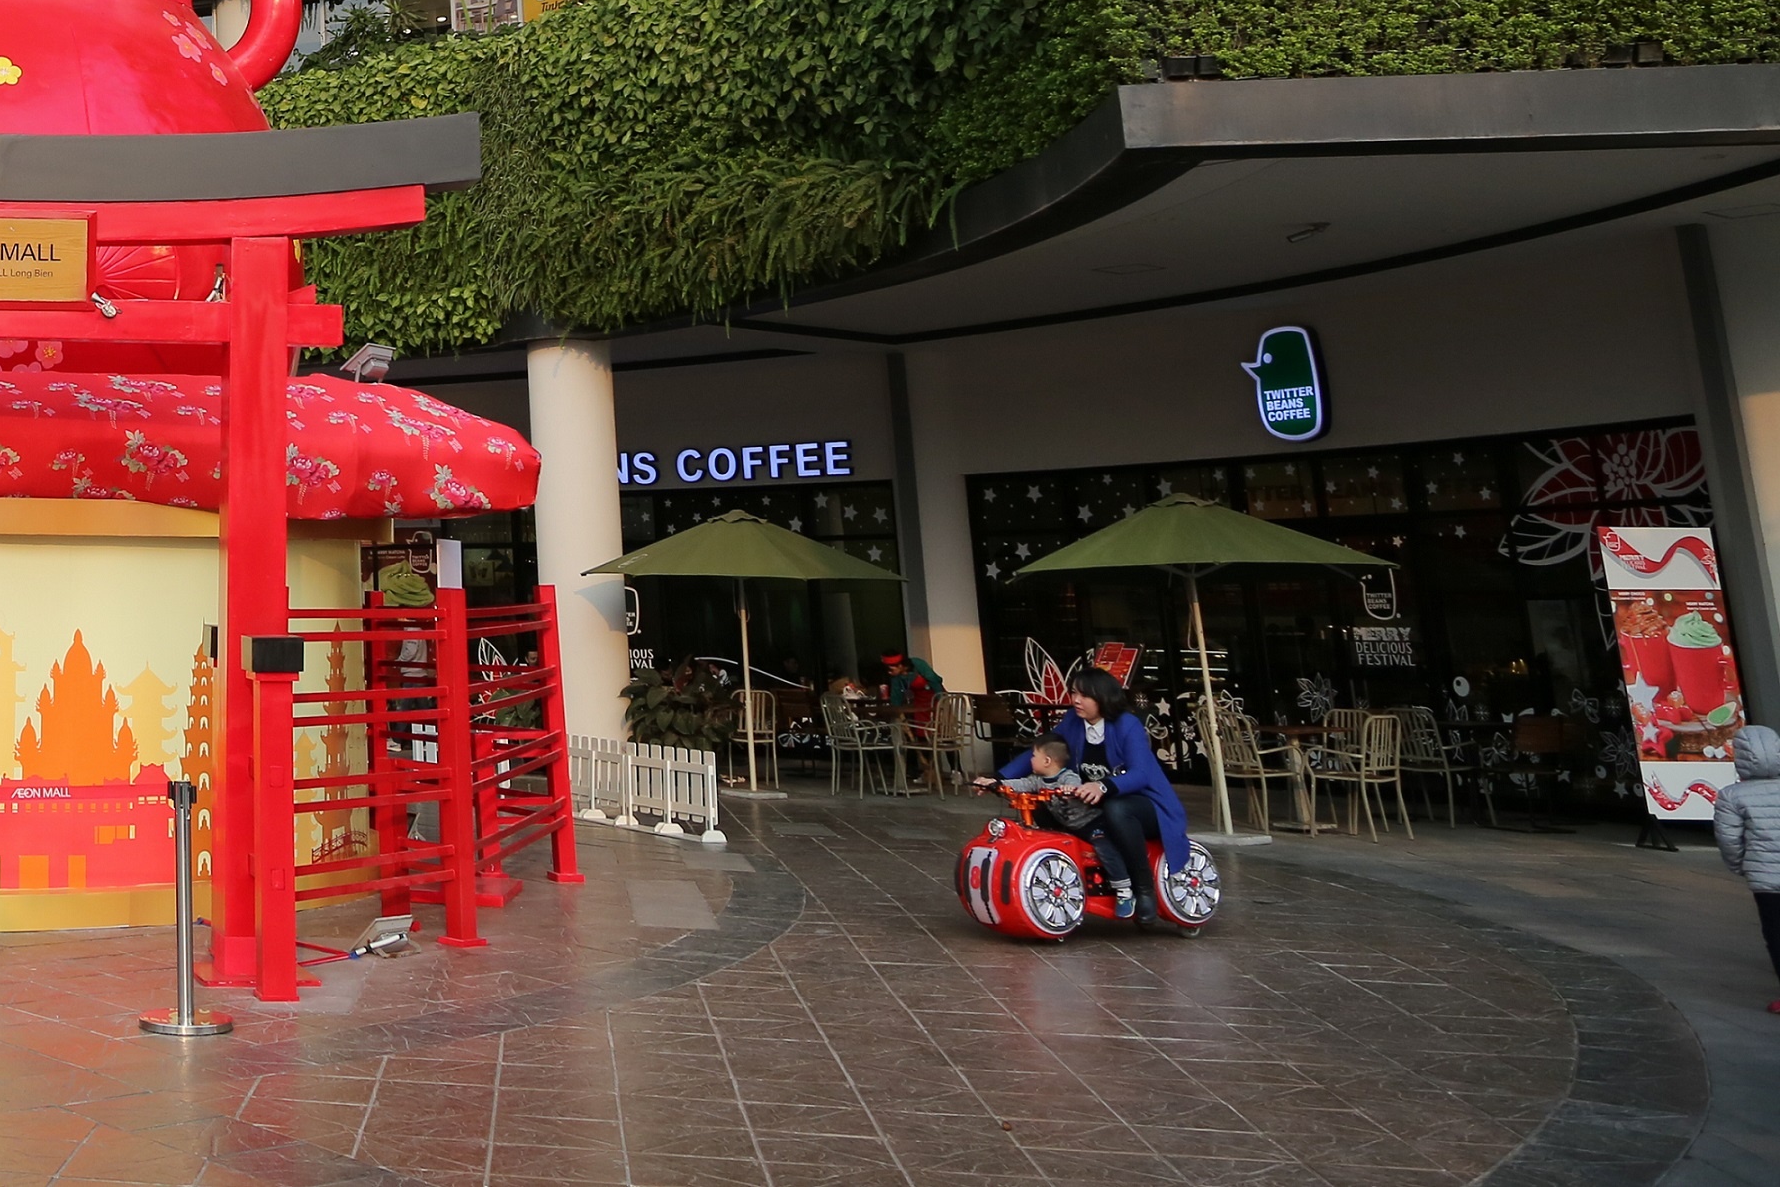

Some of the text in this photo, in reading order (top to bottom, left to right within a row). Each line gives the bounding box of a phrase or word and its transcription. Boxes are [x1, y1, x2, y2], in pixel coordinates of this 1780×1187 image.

[0, 242, 62, 262] MALL
[10, 268, 32, 279] Long
[34, 269, 53, 278] Bien
[1263, 385, 1314, 401] TWITTER
[1266, 397, 1304, 411] BEANS
[1267, 407, 1311, 422] COFFEE
[676, 441, 851, 483] COFFEE
[1352, 627, 1411, 641] MERRY
[1355, 641, 1413, 654] DELICIOUS
[1358, 653, 1416, 667] FESTIVAL
[42, 787, 71, 798] MALL
